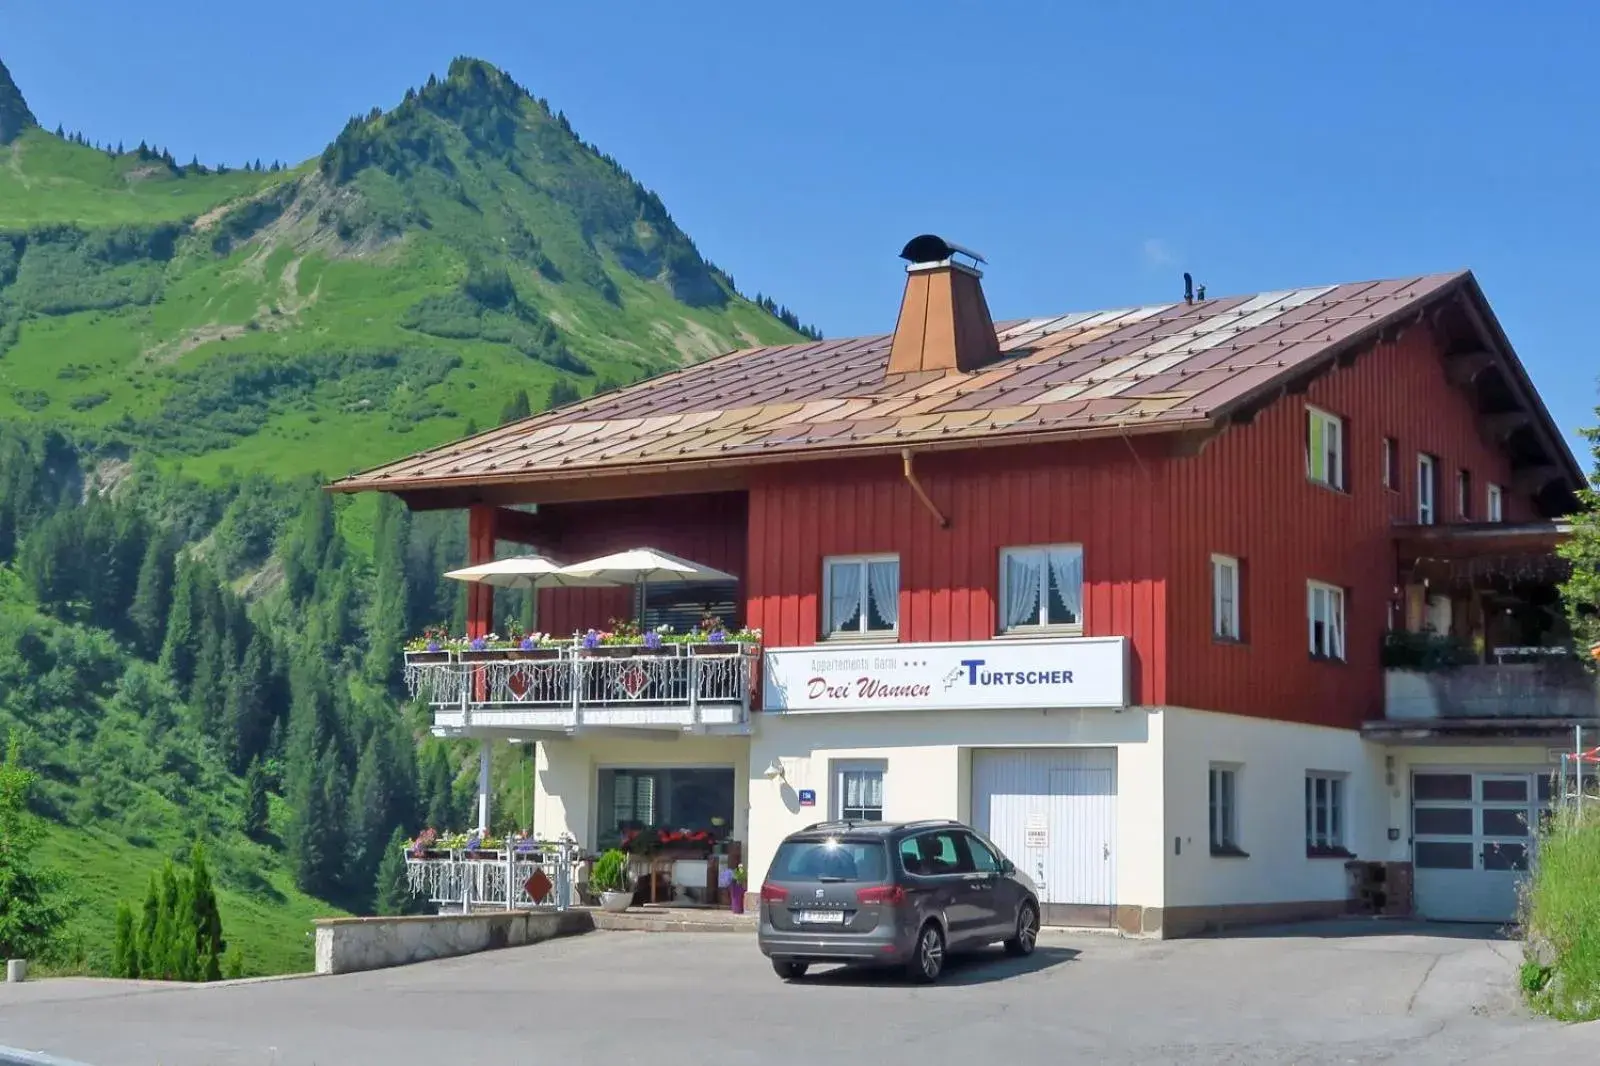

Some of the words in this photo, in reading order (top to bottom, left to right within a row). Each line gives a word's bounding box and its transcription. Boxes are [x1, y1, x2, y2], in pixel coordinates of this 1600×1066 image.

[811, 658, 869, 673] Appartements
[874, 657, 897, 670] Garni
[807, 677, 851, 699] Drei
[856, 676, 931, 699] Wannen
